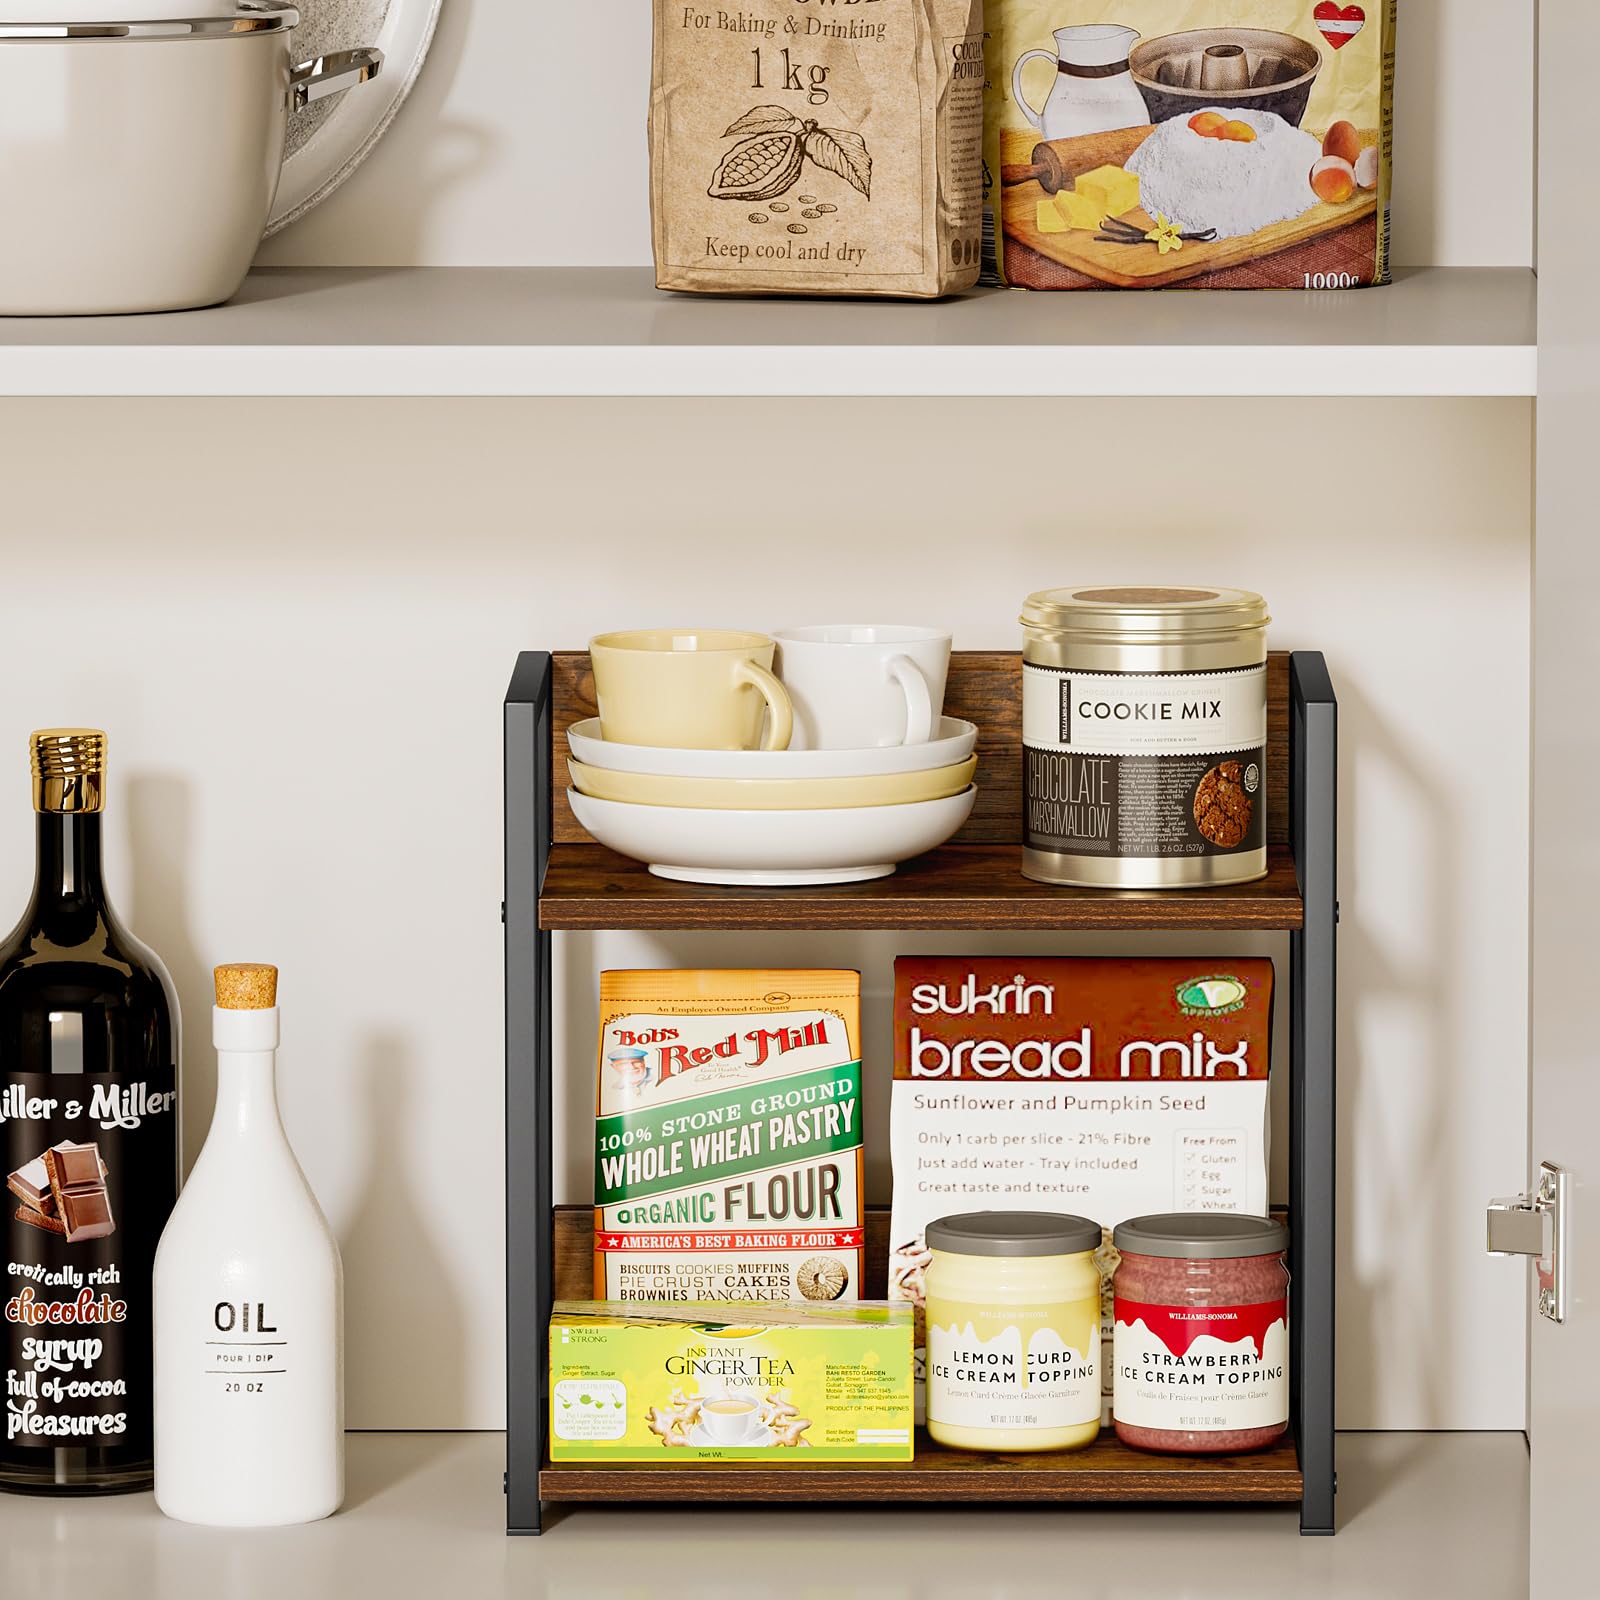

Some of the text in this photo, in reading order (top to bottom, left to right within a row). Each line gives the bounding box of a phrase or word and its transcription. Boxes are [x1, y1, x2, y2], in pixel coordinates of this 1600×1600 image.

[682, 8, 887, 43] For Baking & Drinking
[751, 47, 830, 105] 1 kg
[704, 236, 867, 267] Keep cool and dry
[1078, 700, 1221, 720] COOKIE MIX
[1029, 751, 1110, 805] CHOCOLATE
[1029, 800, 1110, 838] MARSHMALLOW
[1185, 843, 1205, 853] (527g)
[911, 973, 1054, 1014] sukrin
[749, 1005, 790, 1013] Company
[612, 1027, 680, 1046] Bob's
[655, 1018, 832, 1088] Red Mill
[910, 1027, 1247, 1078] bread mix
[65, 1100, 83, 1120] &
[89, 1082, 177, 1130] Miller
[914, 1094, 1206, 1115] Sunflower and Pumpkin Seed
[600, 1078, 853, 1152] 100% STONE GROUND
[601, 1098, 856, 1190] WHOLE WHEAT PASTRY
[918, 1132, 951, 1148] Only
[967, 1132, 998, 1145] carb
[1002, 1136, 1025, 1148] per
[1031, 1132, 1062, 1145] slice
[1078, 1133, 1108, 1145] 21%
[1113, 1133, 1151, 1145] Fibre
[1183, 1137, 1205, 1145] Free
[917, 1158, 946, 1170] Just
[951, 1157, 978, 1170] add
[983, 1158, 1025, 1170] water
[1040, 1158, 1071, 1172] Tray
[1074, 1157, 1138, 1170] included
[1201, 1155, 1237, 1164] Gluten
[617, 1163, 843, 1224] ORGANIC FLOUR
[918, 1182, 1090, 1194] Great taste and texture
[621, 1236, 691, 1249] AMERICA'S
[695, 1236, 731, 1248] BEST
[737, 1234, 788, 1247] BAKING
[7, 1262, 120, 1289] erotically rich
[620, 1263, 790, 1275] BISCUITS COOKIES MUFFINS
[620, 1275, 791, 1288] PIE CRUST CAKES
[620, 1289, 791, 1301] BROWNIES PANCAKES
[5, 1287, 127, 1326] chocolate
[214, 1301, 277, 1332] OIL
[21, 1337, 103, 1372] syrup
[216, 1354, 273, 1362] POUR DIP
[687, 1348, 745, 1357] INSTANT
[953, 1350, 1072, 1365] LEMON CURD
[1142, 1352, 1260, 1367] STRAWBERRY
[665, 1356, 795, 1375] GINGER TEA
[932, 1364, 1094, 1383] ICE CREAM TOPPING
[725, 1377, 785, 1387] POWDER
[1121, 1366, 1282, 1385] ICE CREAM TOPPING
[6, 1369, 127, 1403] full of cocoa
[226, 1383, 263, 1392] 20 OZ
[6, 1399, 127, 1440] pleasures
